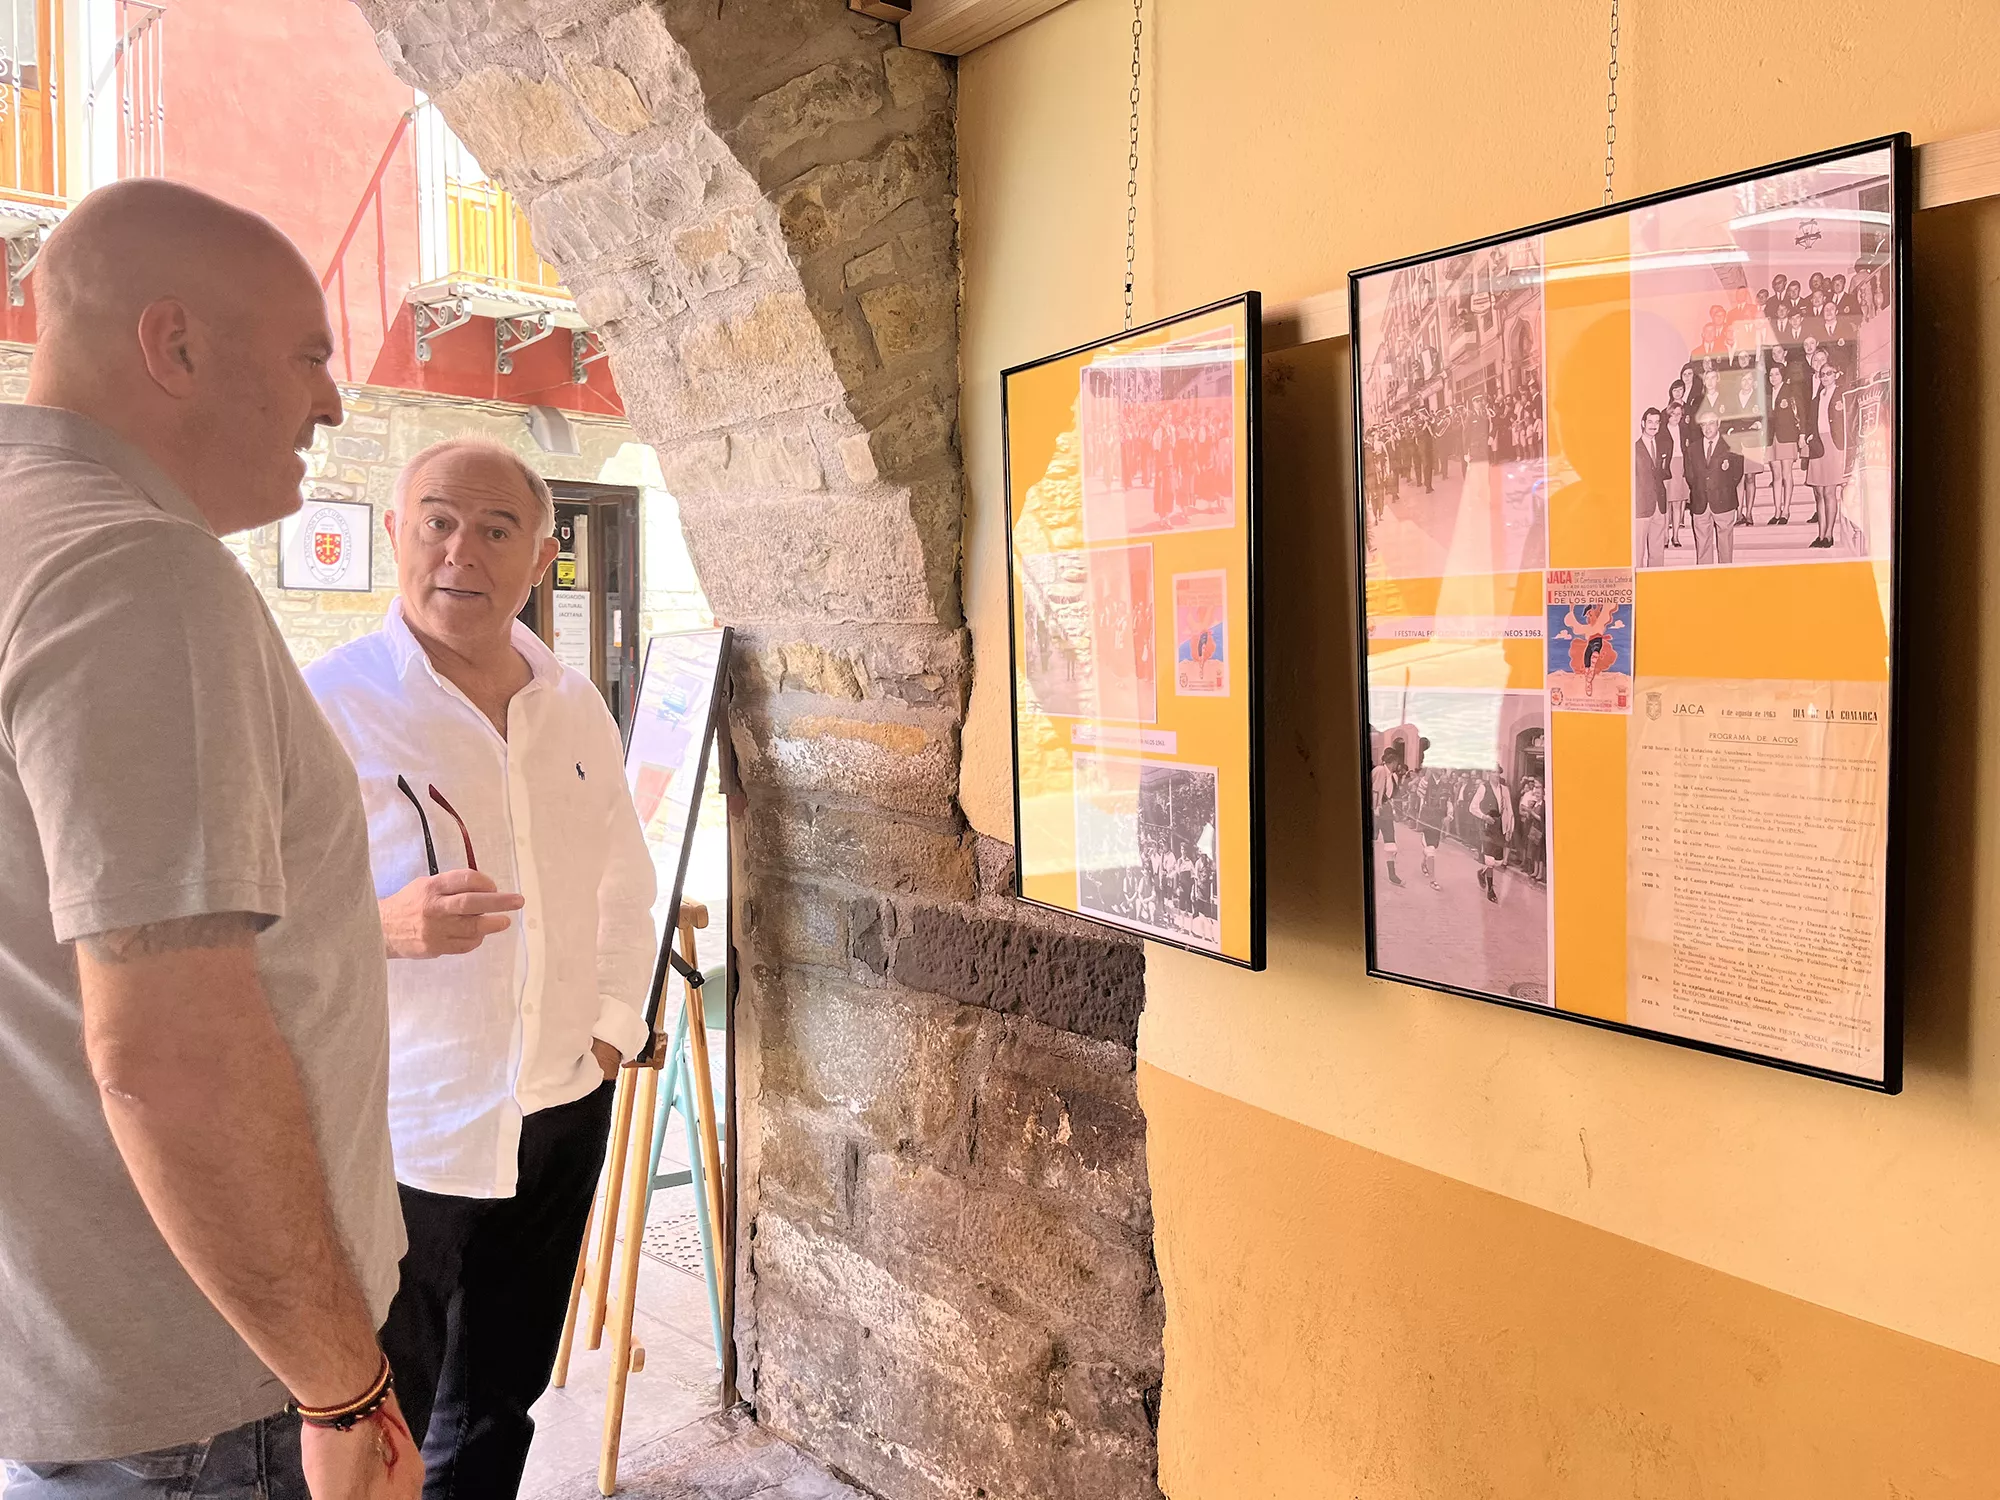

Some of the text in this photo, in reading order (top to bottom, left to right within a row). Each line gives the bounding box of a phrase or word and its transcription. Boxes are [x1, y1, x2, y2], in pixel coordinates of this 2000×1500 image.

[1547, 571, 1572, 584] JACA
[1525, 629, 1543, 637] 1963.
[1672, 703, 1705, 715] JACA
[1735, 710, 1753, 718] agosto
[1793, 708, 1805, 718] DIA
[1825, 710, 1835, 720] LA
[1840, 711, 1878, 721] COMARCA
[1708, 732, 1751, 741] PROGRAMA
